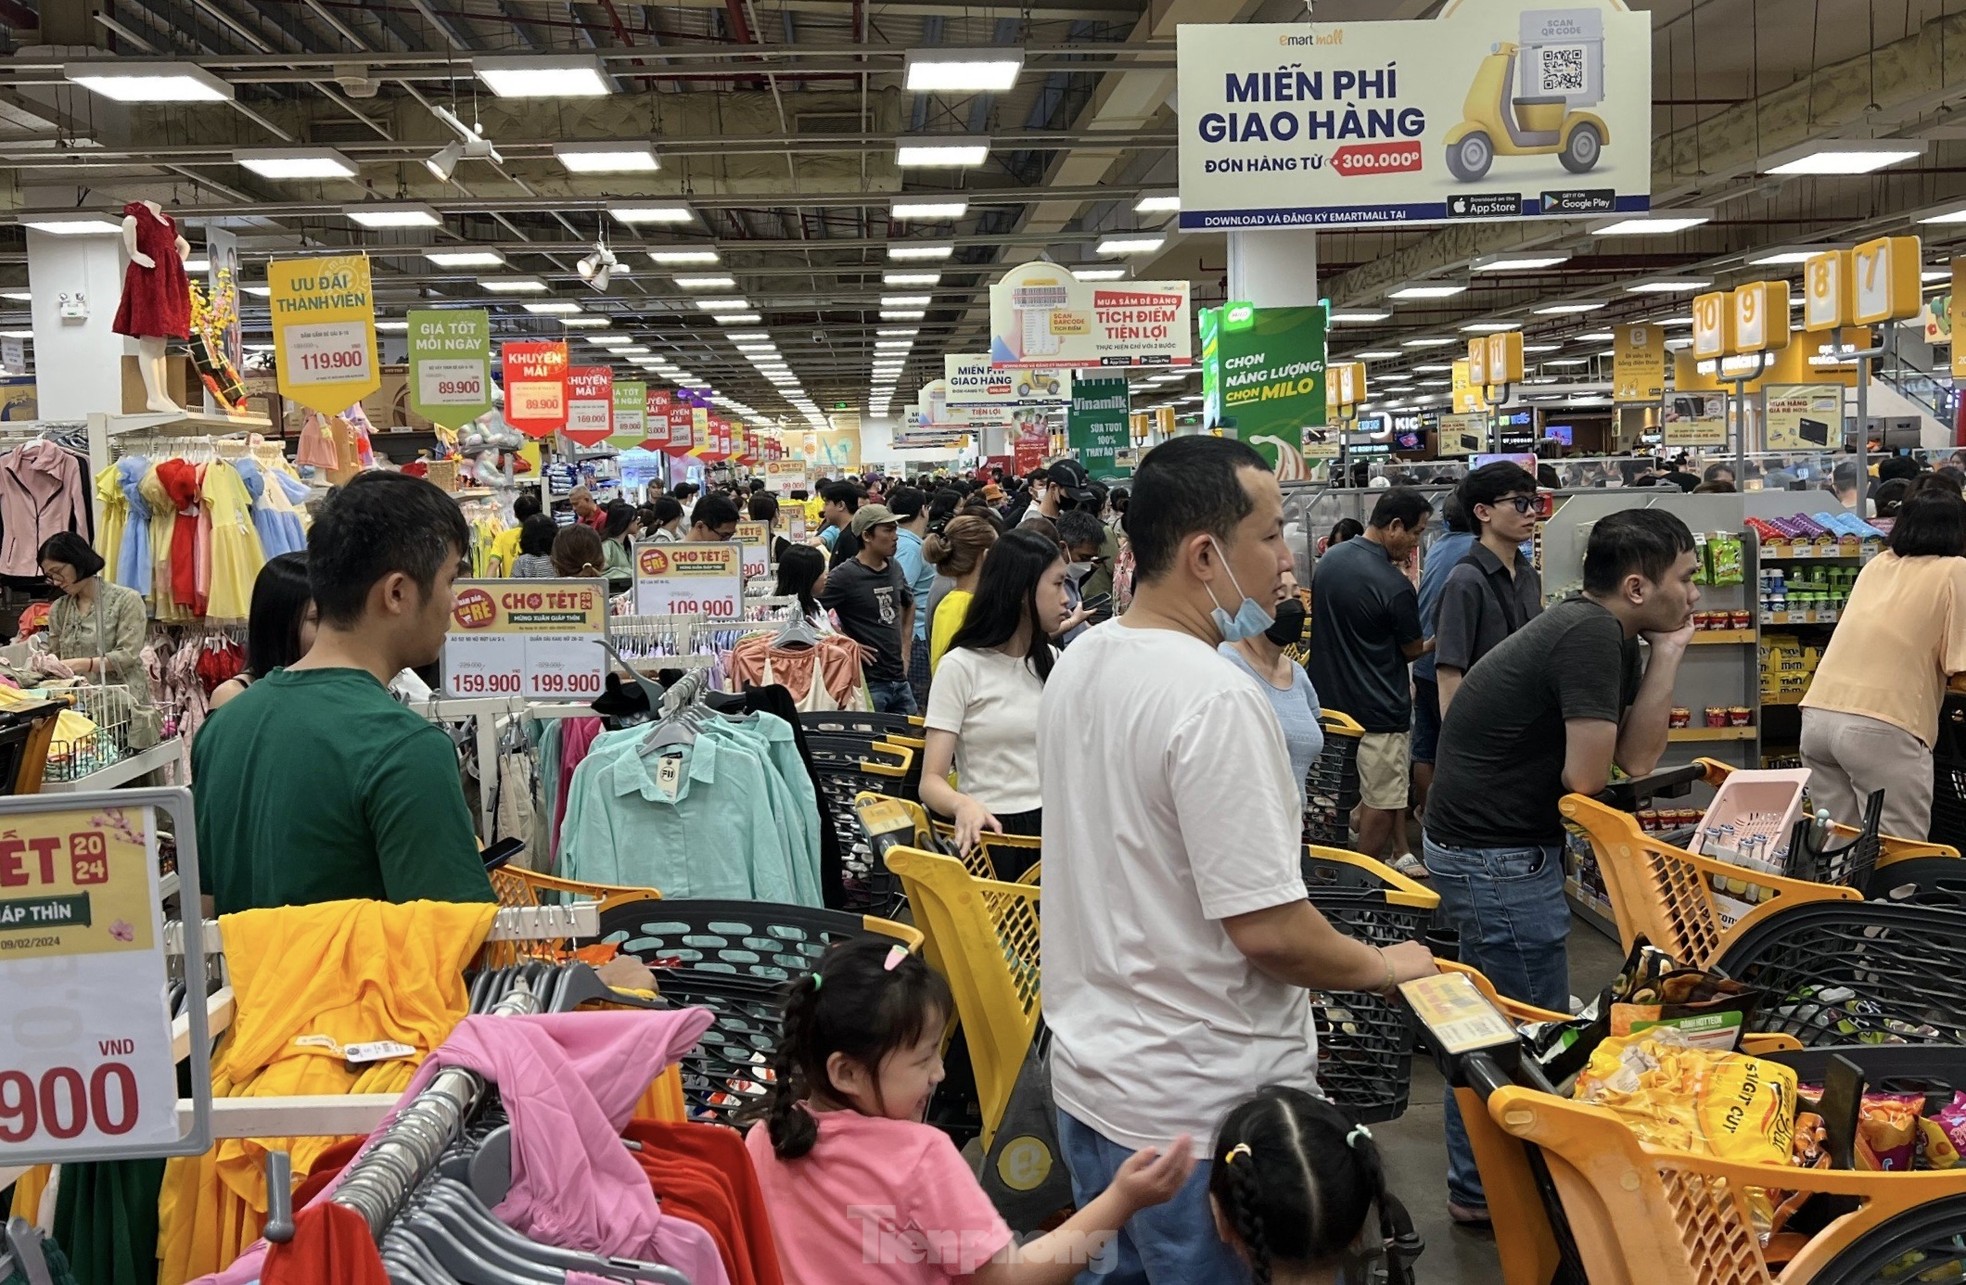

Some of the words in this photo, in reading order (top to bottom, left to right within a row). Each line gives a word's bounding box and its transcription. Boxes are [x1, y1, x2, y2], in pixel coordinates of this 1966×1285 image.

[1547, 19, 1574, 27] SCAN
[1555, 26, 1582, 35] CODE
[1279, 33, 1313, 46] emart
[1316, 29, 1343, 45] mall
[1226, 63, 1323, 102] MIỄN
[1333, 61, 1396, 100] PHÍ
[1199, 111, 1298, 143] GIAO
[1309, 102, 1425, 140] HÀNG
[1205, 158, 1243, 173] ĐƠN
[1247, 155, 1297, 172] HÀNG
[1300, 153, 1323, 170] TỪ
[1470, 203, 1492, 214] App
[1492, 203, 1516, 212] Store
[1562, 199, 1592, 209] Google
[1593, 197, 1610, 208] Play
[1205, 216, 1265, 226] DOWNLOAD
[1267, 213, 1281, 224] VÀ
[1282, 213, 1313, 224] ĐĂNG
[1315, 211, 1328, 222] KÝ
[1329, 211, 1388, 221] EMARTMALL
[1390, 210, 1406, 221] TẠI
[1860, 246, 1880, 292] 7
[291, 277, 314, 292] ƯU
[319, 273, 348, 290] ĐÃI
[1814, 258, 1829, 298] 8
[277, 295, 329, 313] THÀNH
[330, 291, 366, 308] VIÊN
[1119, 296, 1138, 305] SẮM
[1152, 297, 1177, 305] DÀNG
[1743, 290, 1755, 323] 9
[1096, 309, 1133, 323] TÍCH
[1136, 306, 1175, 322] ĐIỂM
[1697, 299, 1717, 331] 10
[420, 321, 445, 335] GIÁ
[448, 320, 476, 335] TỐT
[1105, 324, 1139, 342] TIỆN
[1143, 325, 1167, 341] LỢI
[416, 335, 441, 350] MỖI
[445, 336, 481, 350] NGÀY
[301, 350, 362, 370] 119.900
[509, 351, 562, 364] KHUYẾN
[1225, 353, 1265, 369] CHỌN
[524, 365, 548, 377] MÃI
[958, 364, 984, 375] MIỄN
[1226, 370, 1268, 387] NĂNG
[1270, 360, 1324, 379] LƯỢNG,
[439, 381, 480, 394] 89.900
[951, 377, 978, 386] GIAO
[980, 375, 1012, 385] HÀNG
[1226, 387, 1259, 401] CHỌN
[1261, 378, 1314, 401] MILO
[526, 399, 559, 410] 89.900
[1073, 396, 1127, 411] Vinamilk
[672, 551, 698, 563] CHỢ
[700, 549, 720, 562] TẾT
[502, 592, 543, 611] CHỢ
[546, 590, 578, 609] TẾT
[453, 674, 521, 692] 159.900
[531, 674, 600, 693] 199.900
[73, 836, 102, 855] 20
[0, 830, 61, 887] ẾT
[76, 860, 105, 880] 24
[0, 905, 26, 923] ÁP
[29, 902, 72, 920] THÌN
[0, 937, 61, 950] 09/02/2024
[98, 1039, 135, 1056] VND
[1722, 1105, 1745, 1134] CUT
